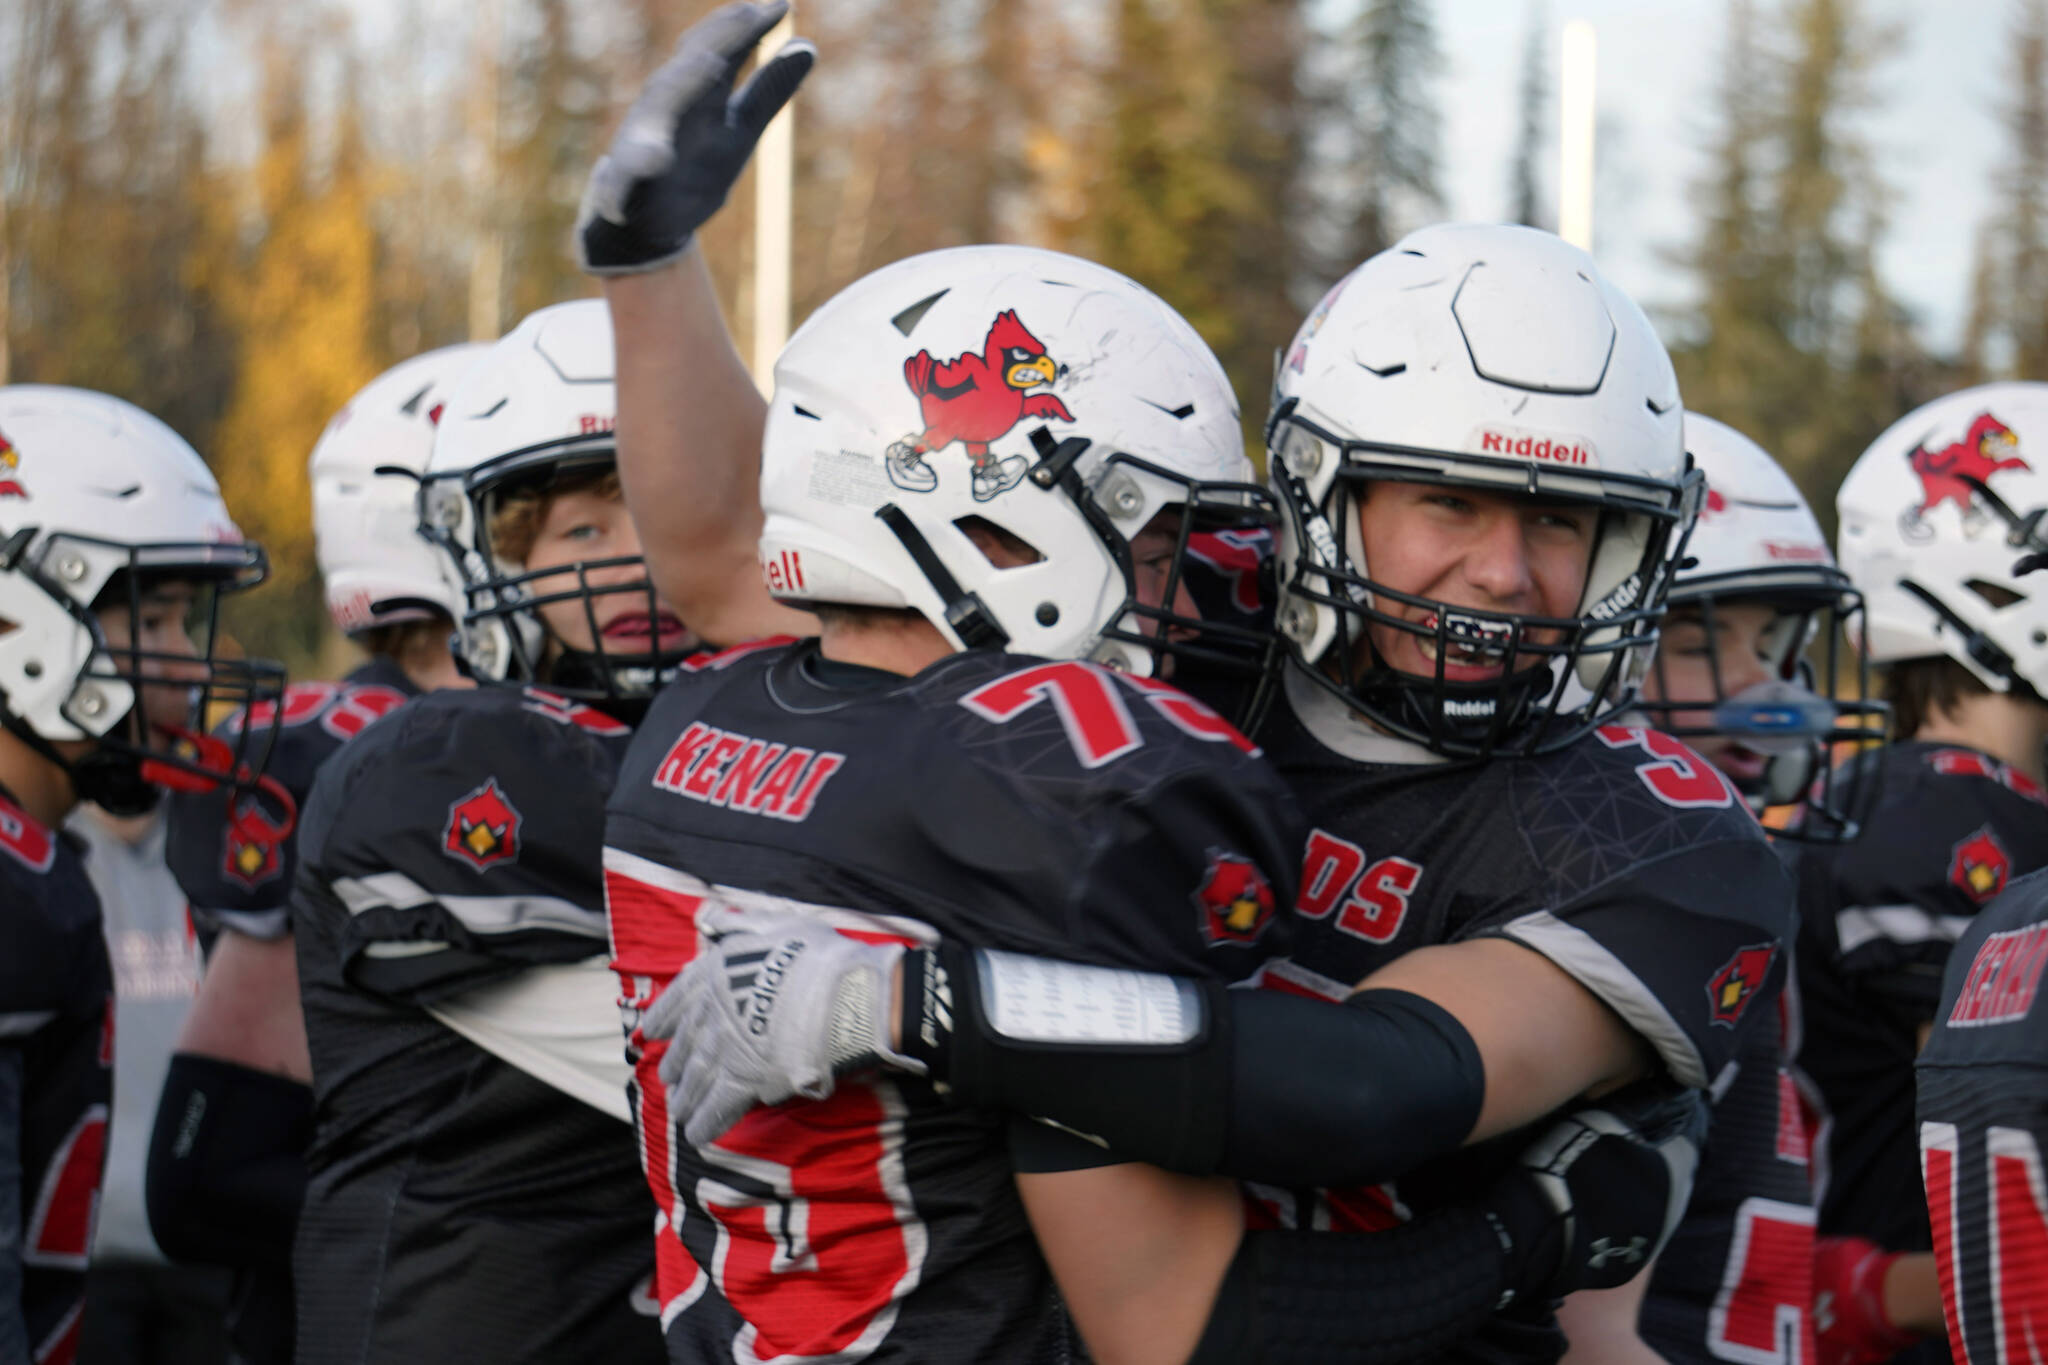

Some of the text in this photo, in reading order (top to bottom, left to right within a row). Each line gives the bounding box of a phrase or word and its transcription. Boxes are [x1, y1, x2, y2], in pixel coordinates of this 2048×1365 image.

[1481, 431, 1588, 465] Riddell
[763, 550, 804, 591] ell
[652, 720, 847, 823] KENAI
[749, 939, 807, 1036] adidas
